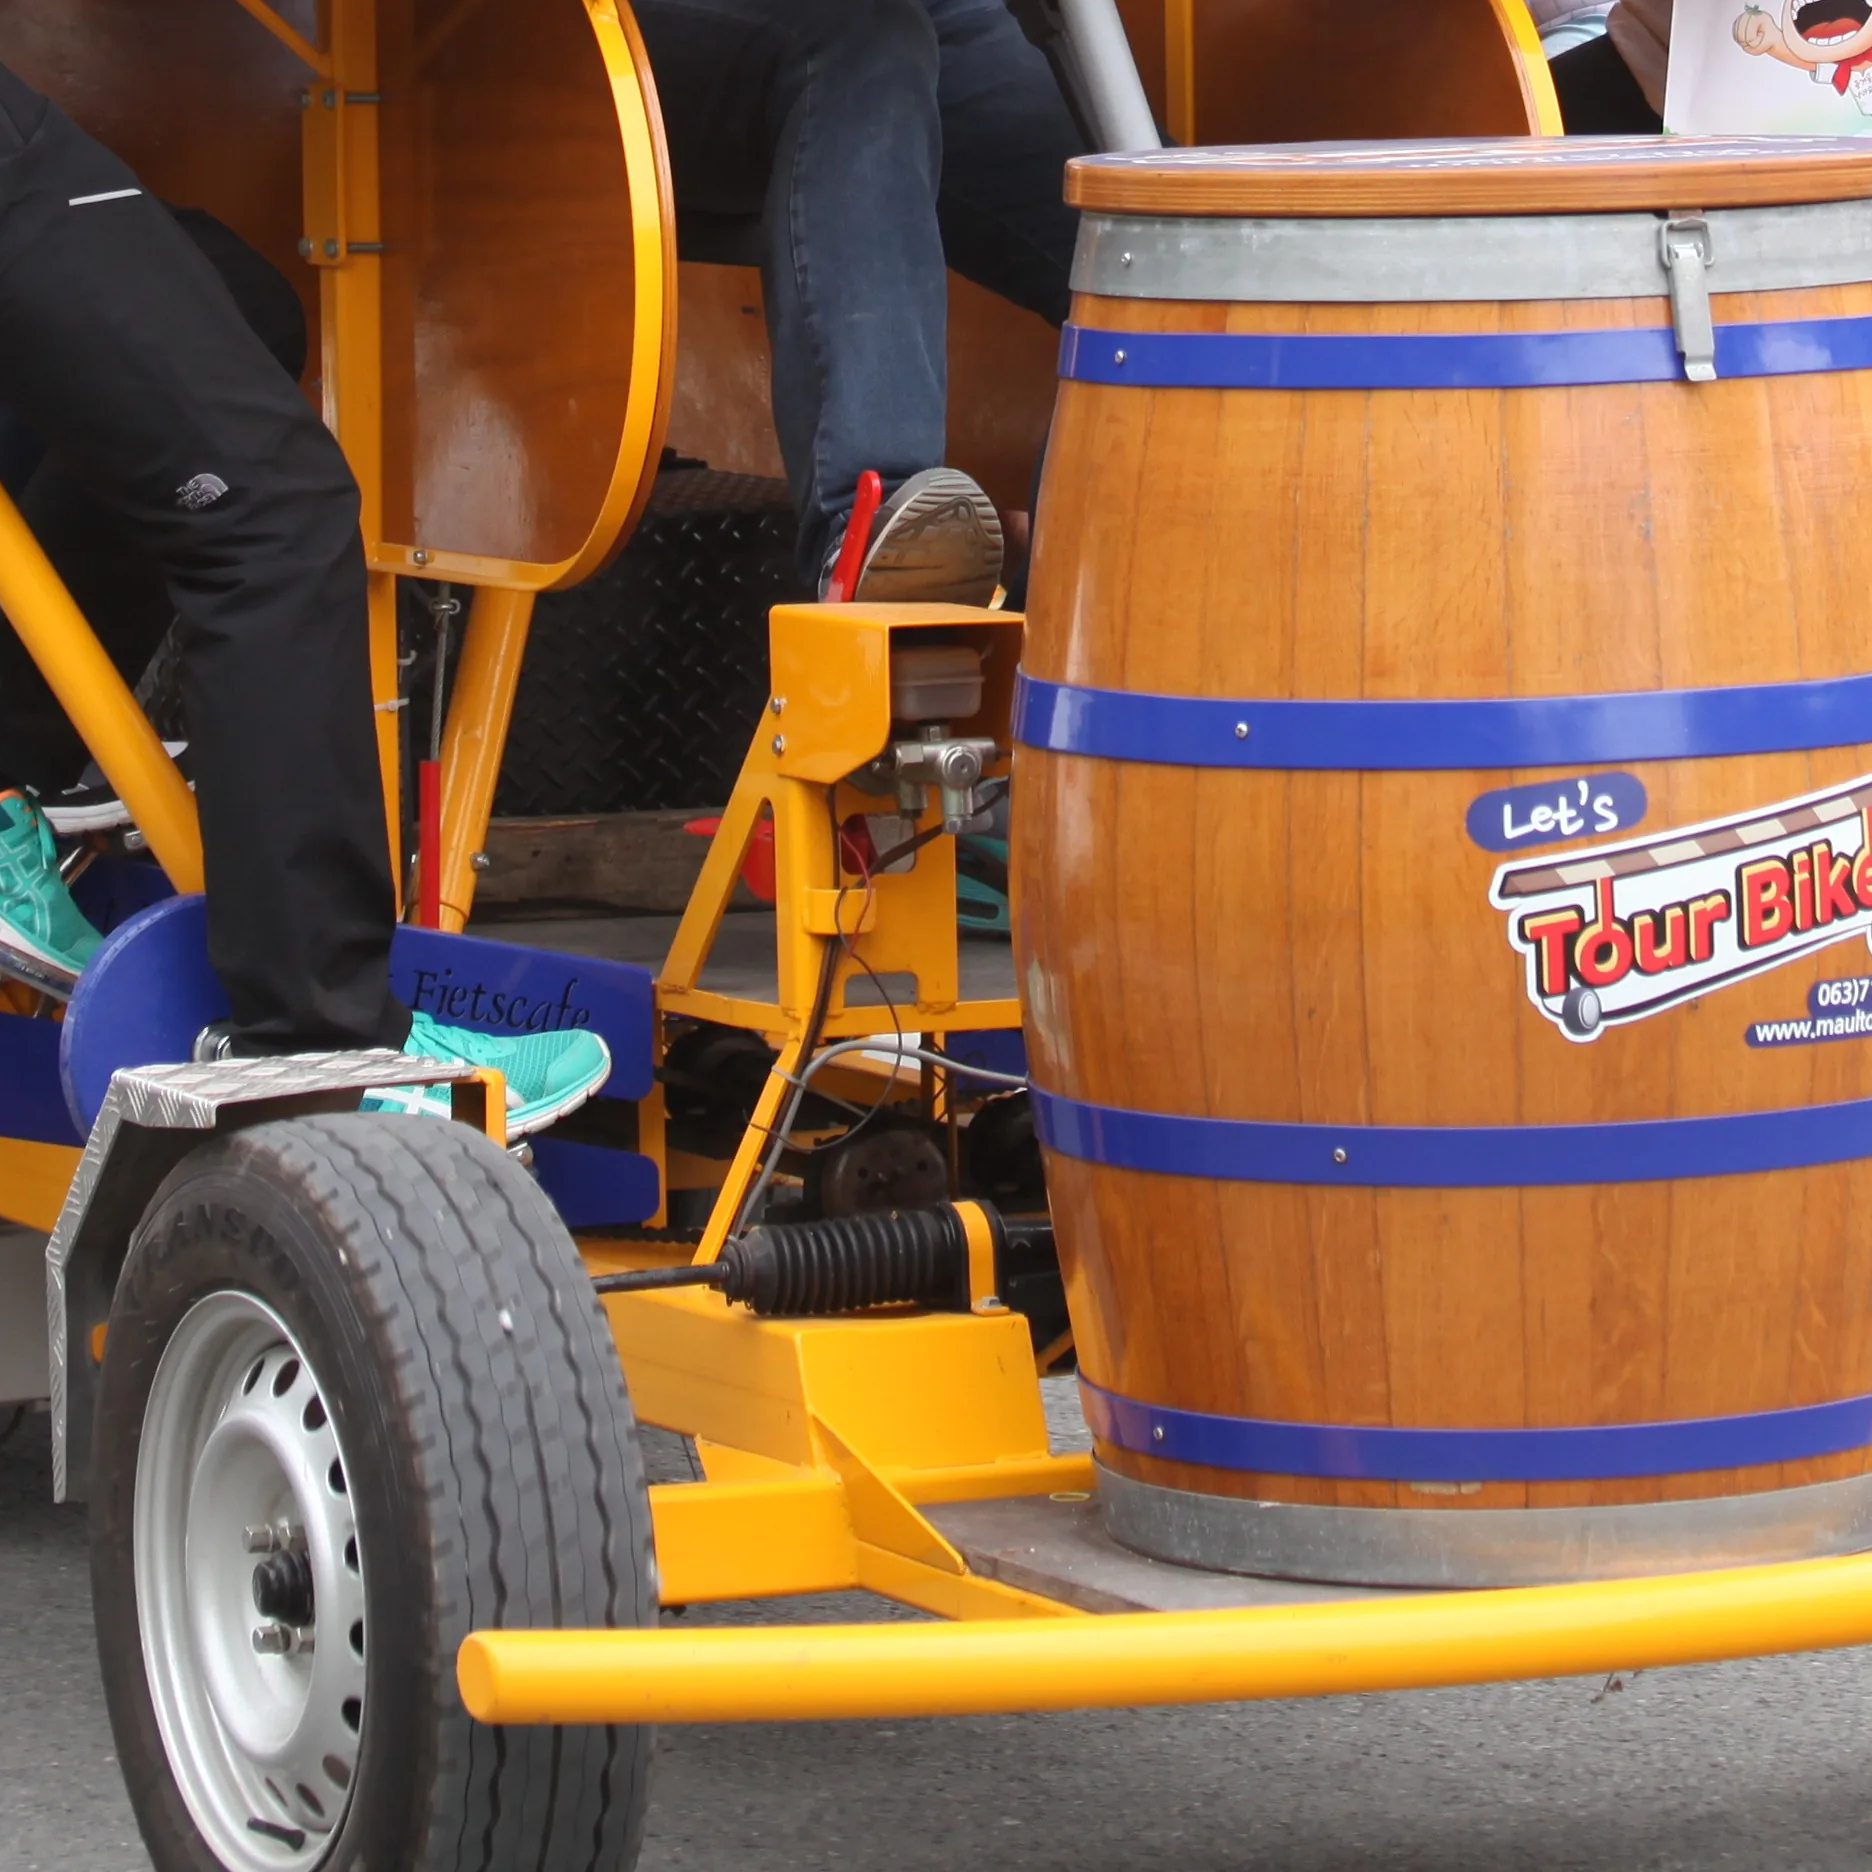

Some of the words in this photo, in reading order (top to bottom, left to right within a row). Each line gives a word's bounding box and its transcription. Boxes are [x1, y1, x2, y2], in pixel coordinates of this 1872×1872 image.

[1502, 780, 1619, 840] Let's
[1524, 890, 1730, 996] Tour
[409, 968, 592, 1032] Fietscafe
